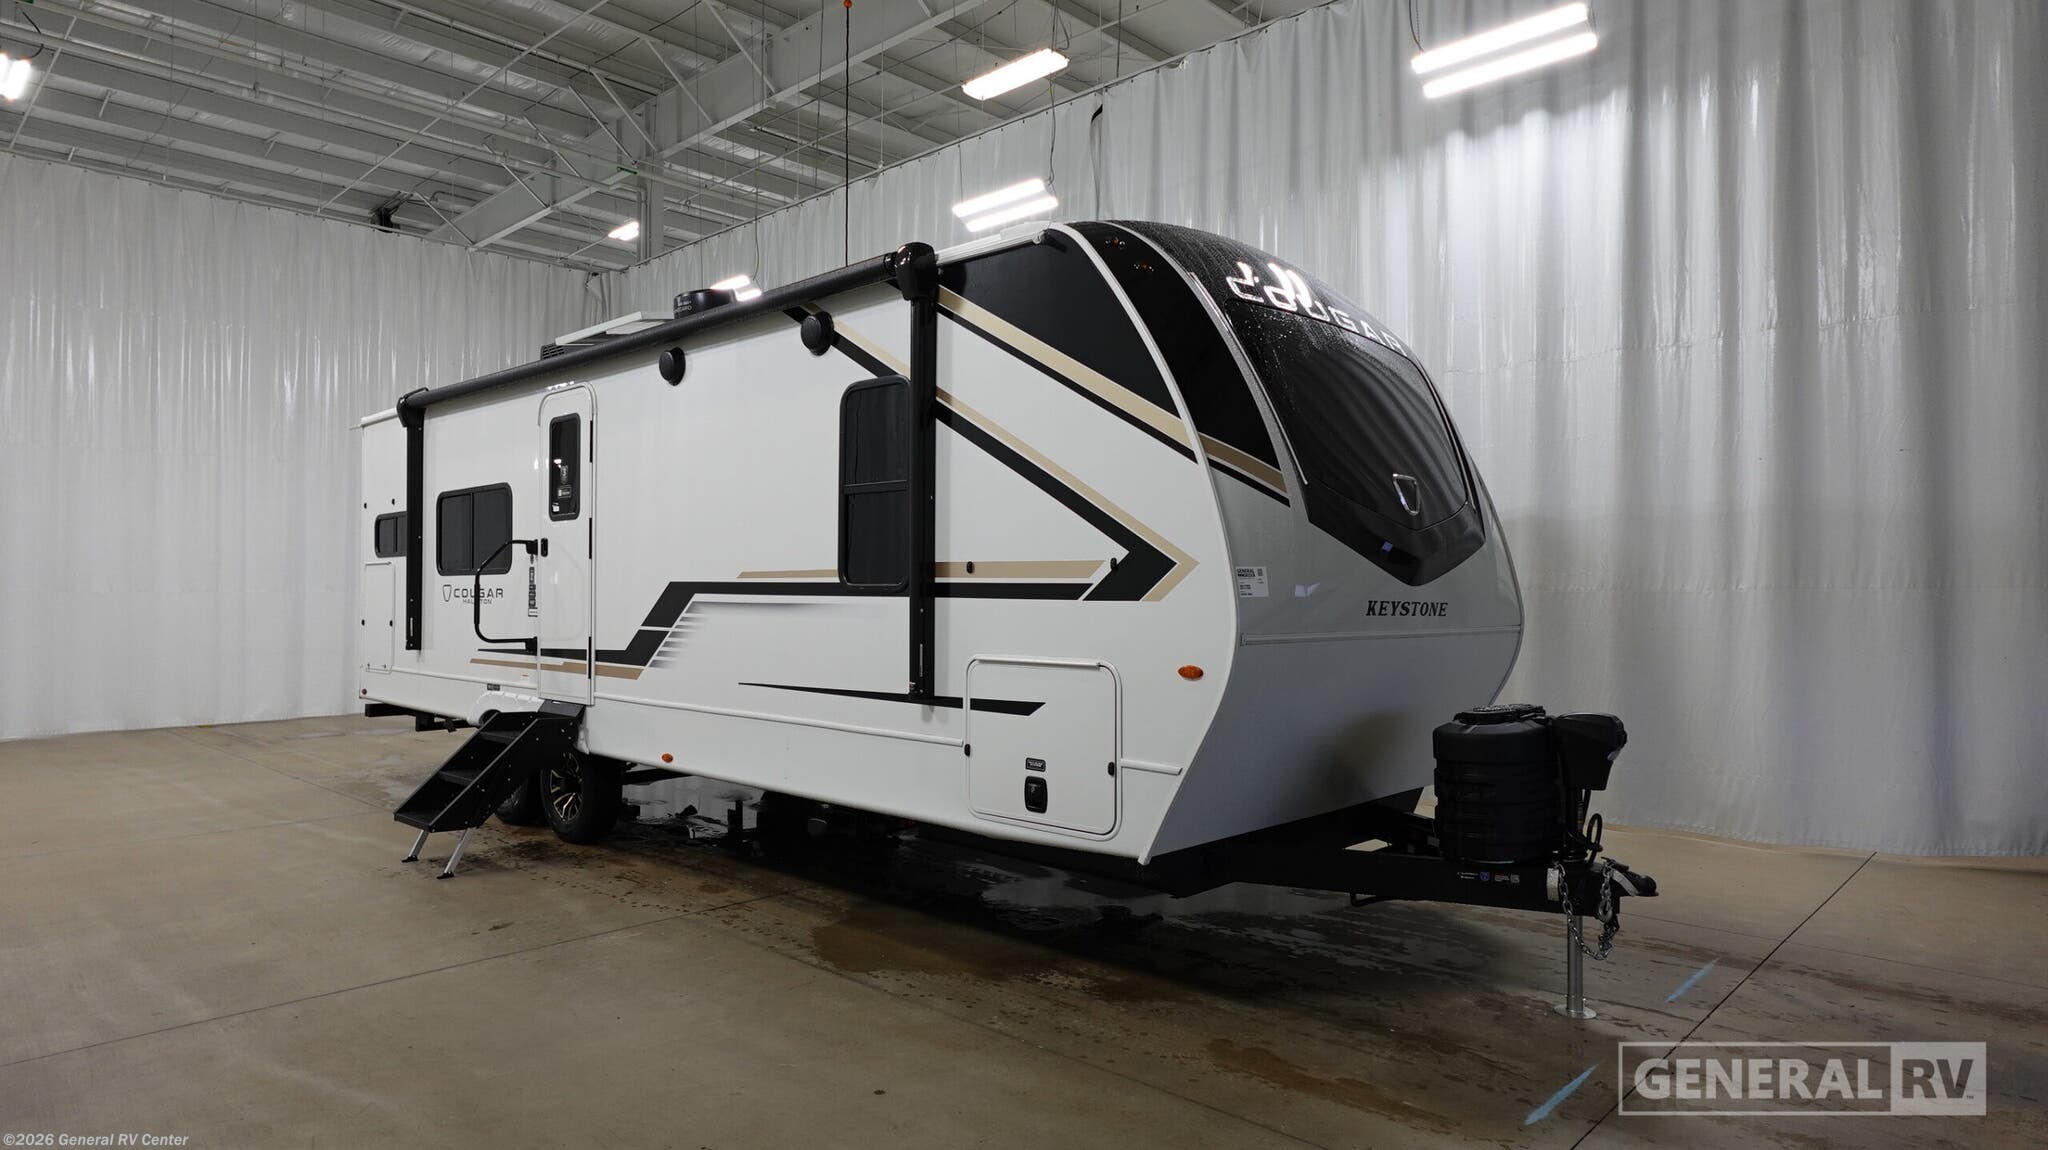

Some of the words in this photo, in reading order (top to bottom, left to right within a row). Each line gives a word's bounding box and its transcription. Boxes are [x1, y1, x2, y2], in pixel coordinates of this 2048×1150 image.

[1225, 274, 1408, 357] COUGAR
[453, 588, 504, 599] COUGAR
[1365, 600, 1448, 616] KEYSTONE
